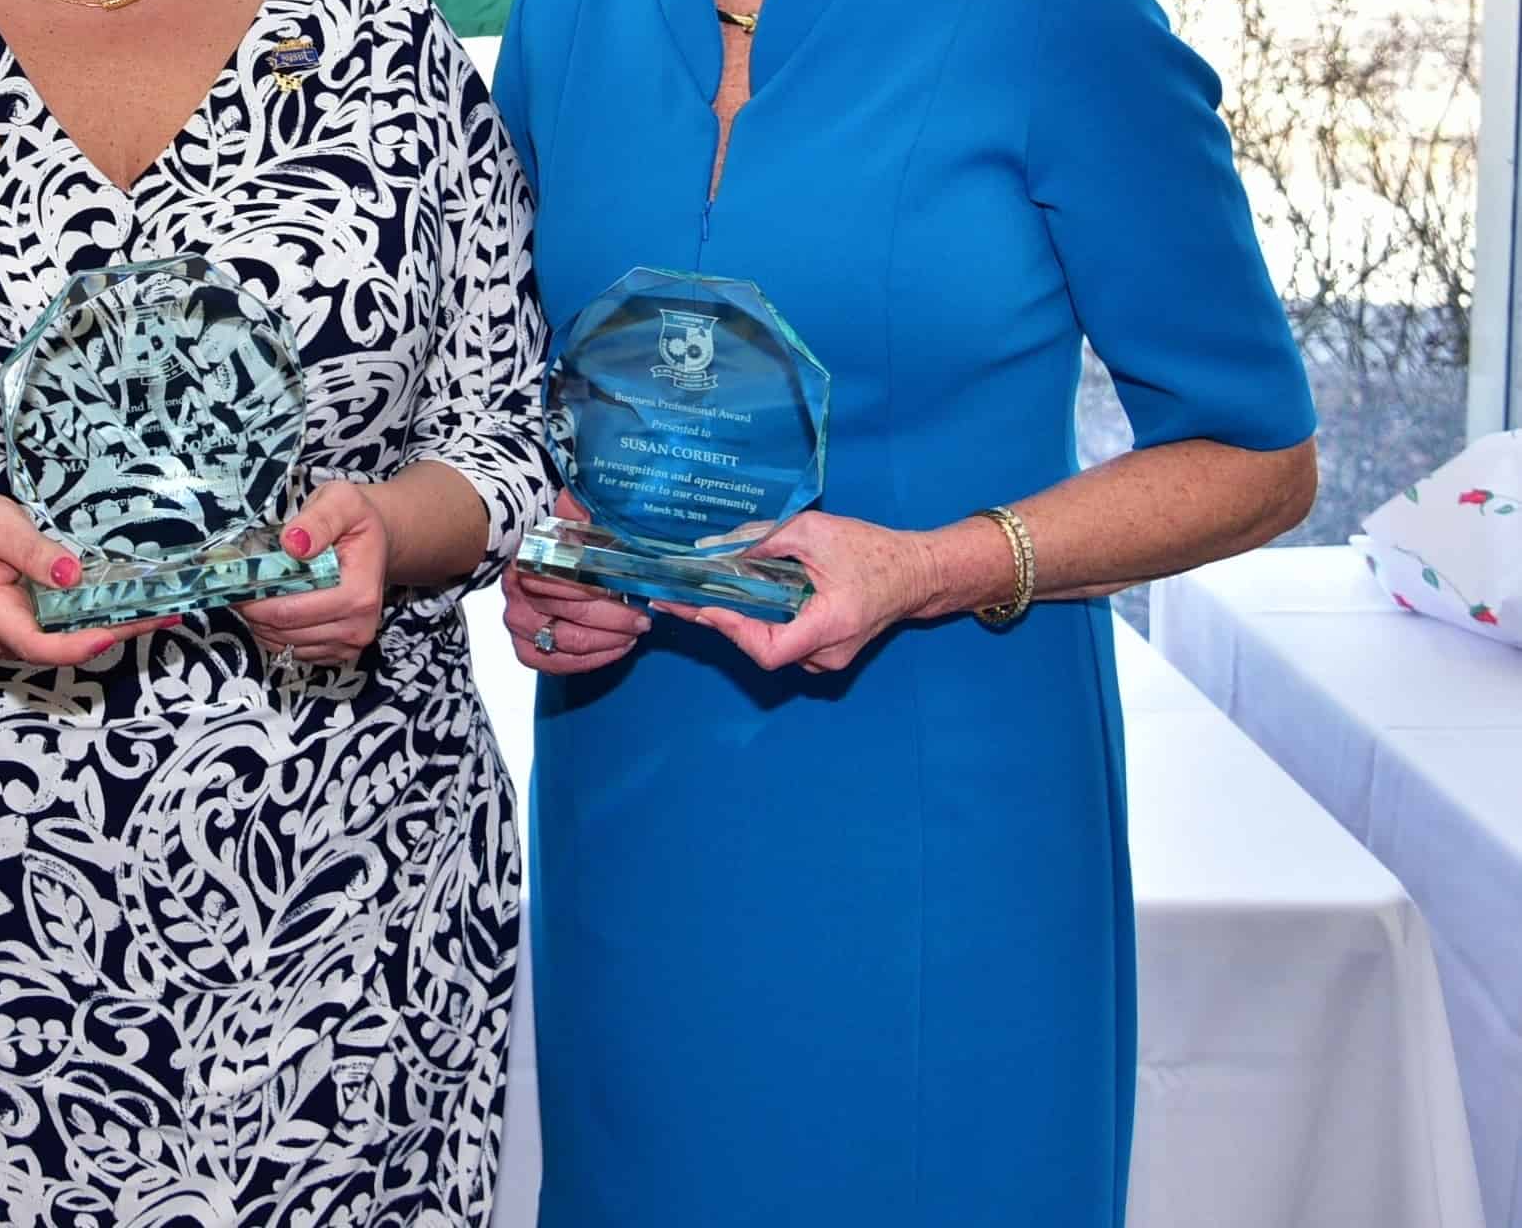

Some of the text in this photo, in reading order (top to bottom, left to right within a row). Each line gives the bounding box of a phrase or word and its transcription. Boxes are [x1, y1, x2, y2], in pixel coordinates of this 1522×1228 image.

[658, 398, 717, 418] Professional
[717, 409, 751, 423] Award
[651, 420, 711, 438] Presented to
[620, 437, 739, 468] SUSAN CORBETT
[593, 456, 766, 496] In recognition and appreciation
[598, 474, 758, 514] For service to our community
